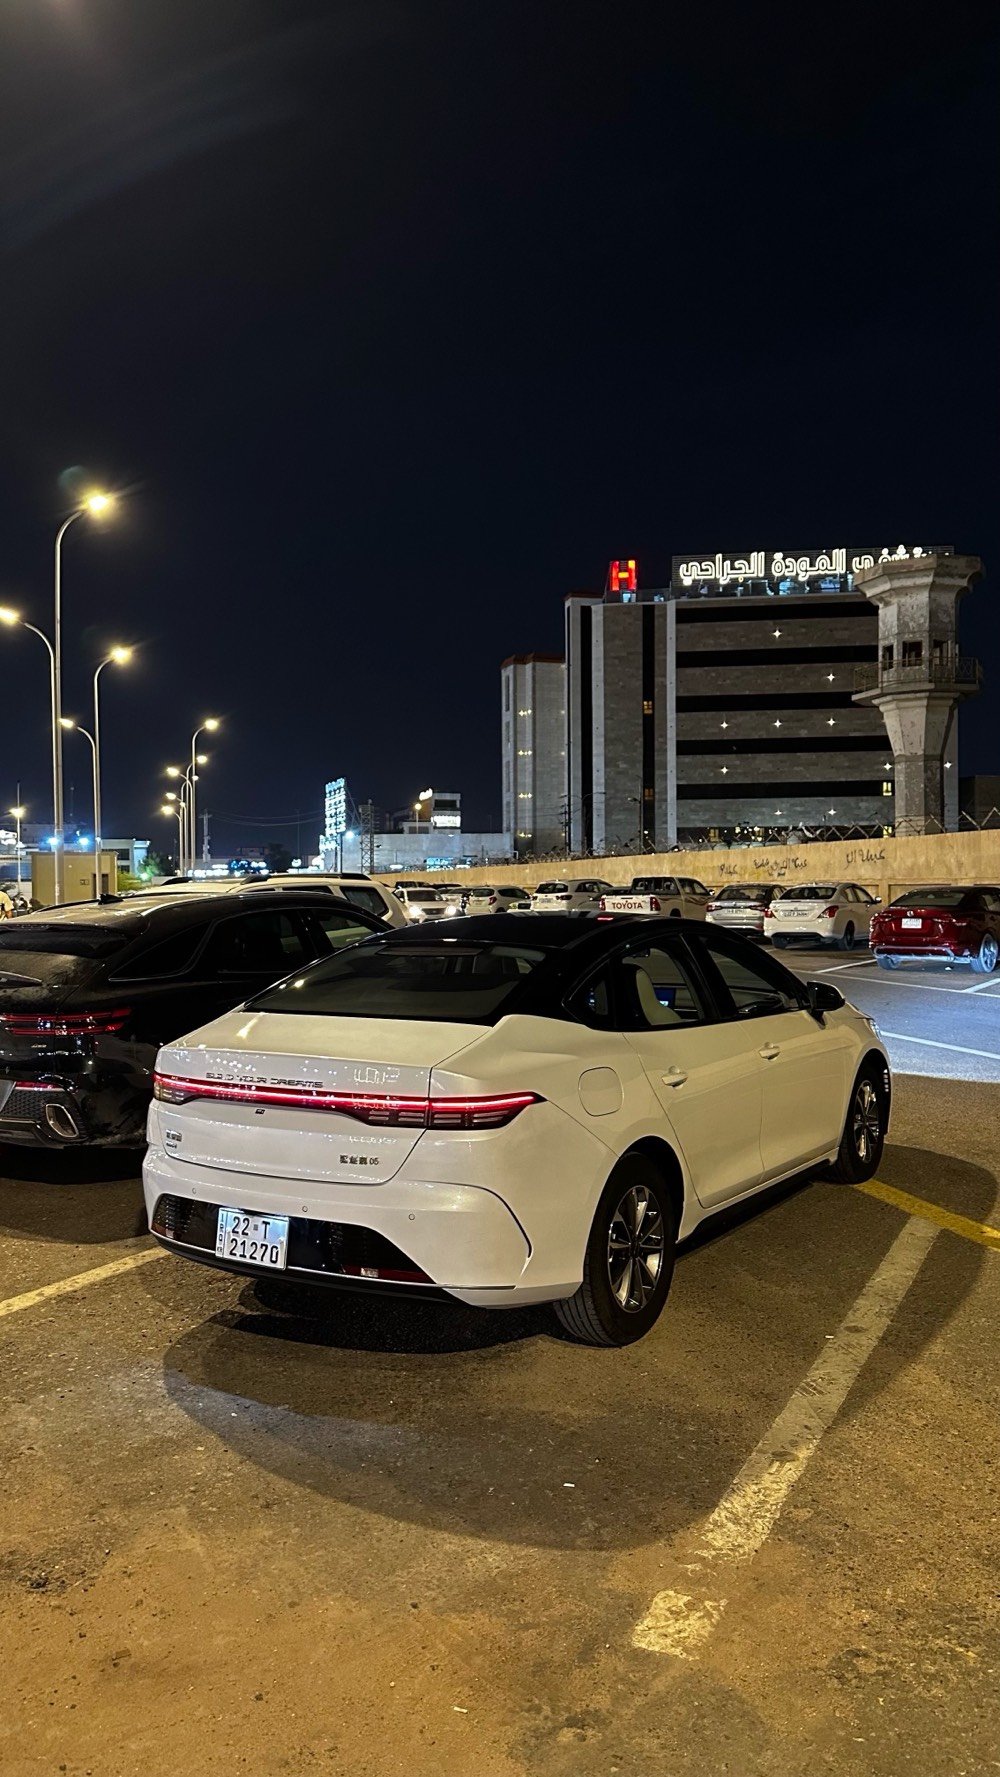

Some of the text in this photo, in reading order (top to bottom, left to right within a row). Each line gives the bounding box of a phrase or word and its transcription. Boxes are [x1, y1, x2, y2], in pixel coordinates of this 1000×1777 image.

[611, 560, 636, 591] H
[679, 551, 766, 586] الجراحي
[611, 902, 643, 910] TOYOTA
[236, 1074, 267, 1084] YOUR
[270, 1077, 324, 1089] DREAMS
[231, 1216, 270, 1240] 22 T
[229, 1238, 279, 1264] 21270
